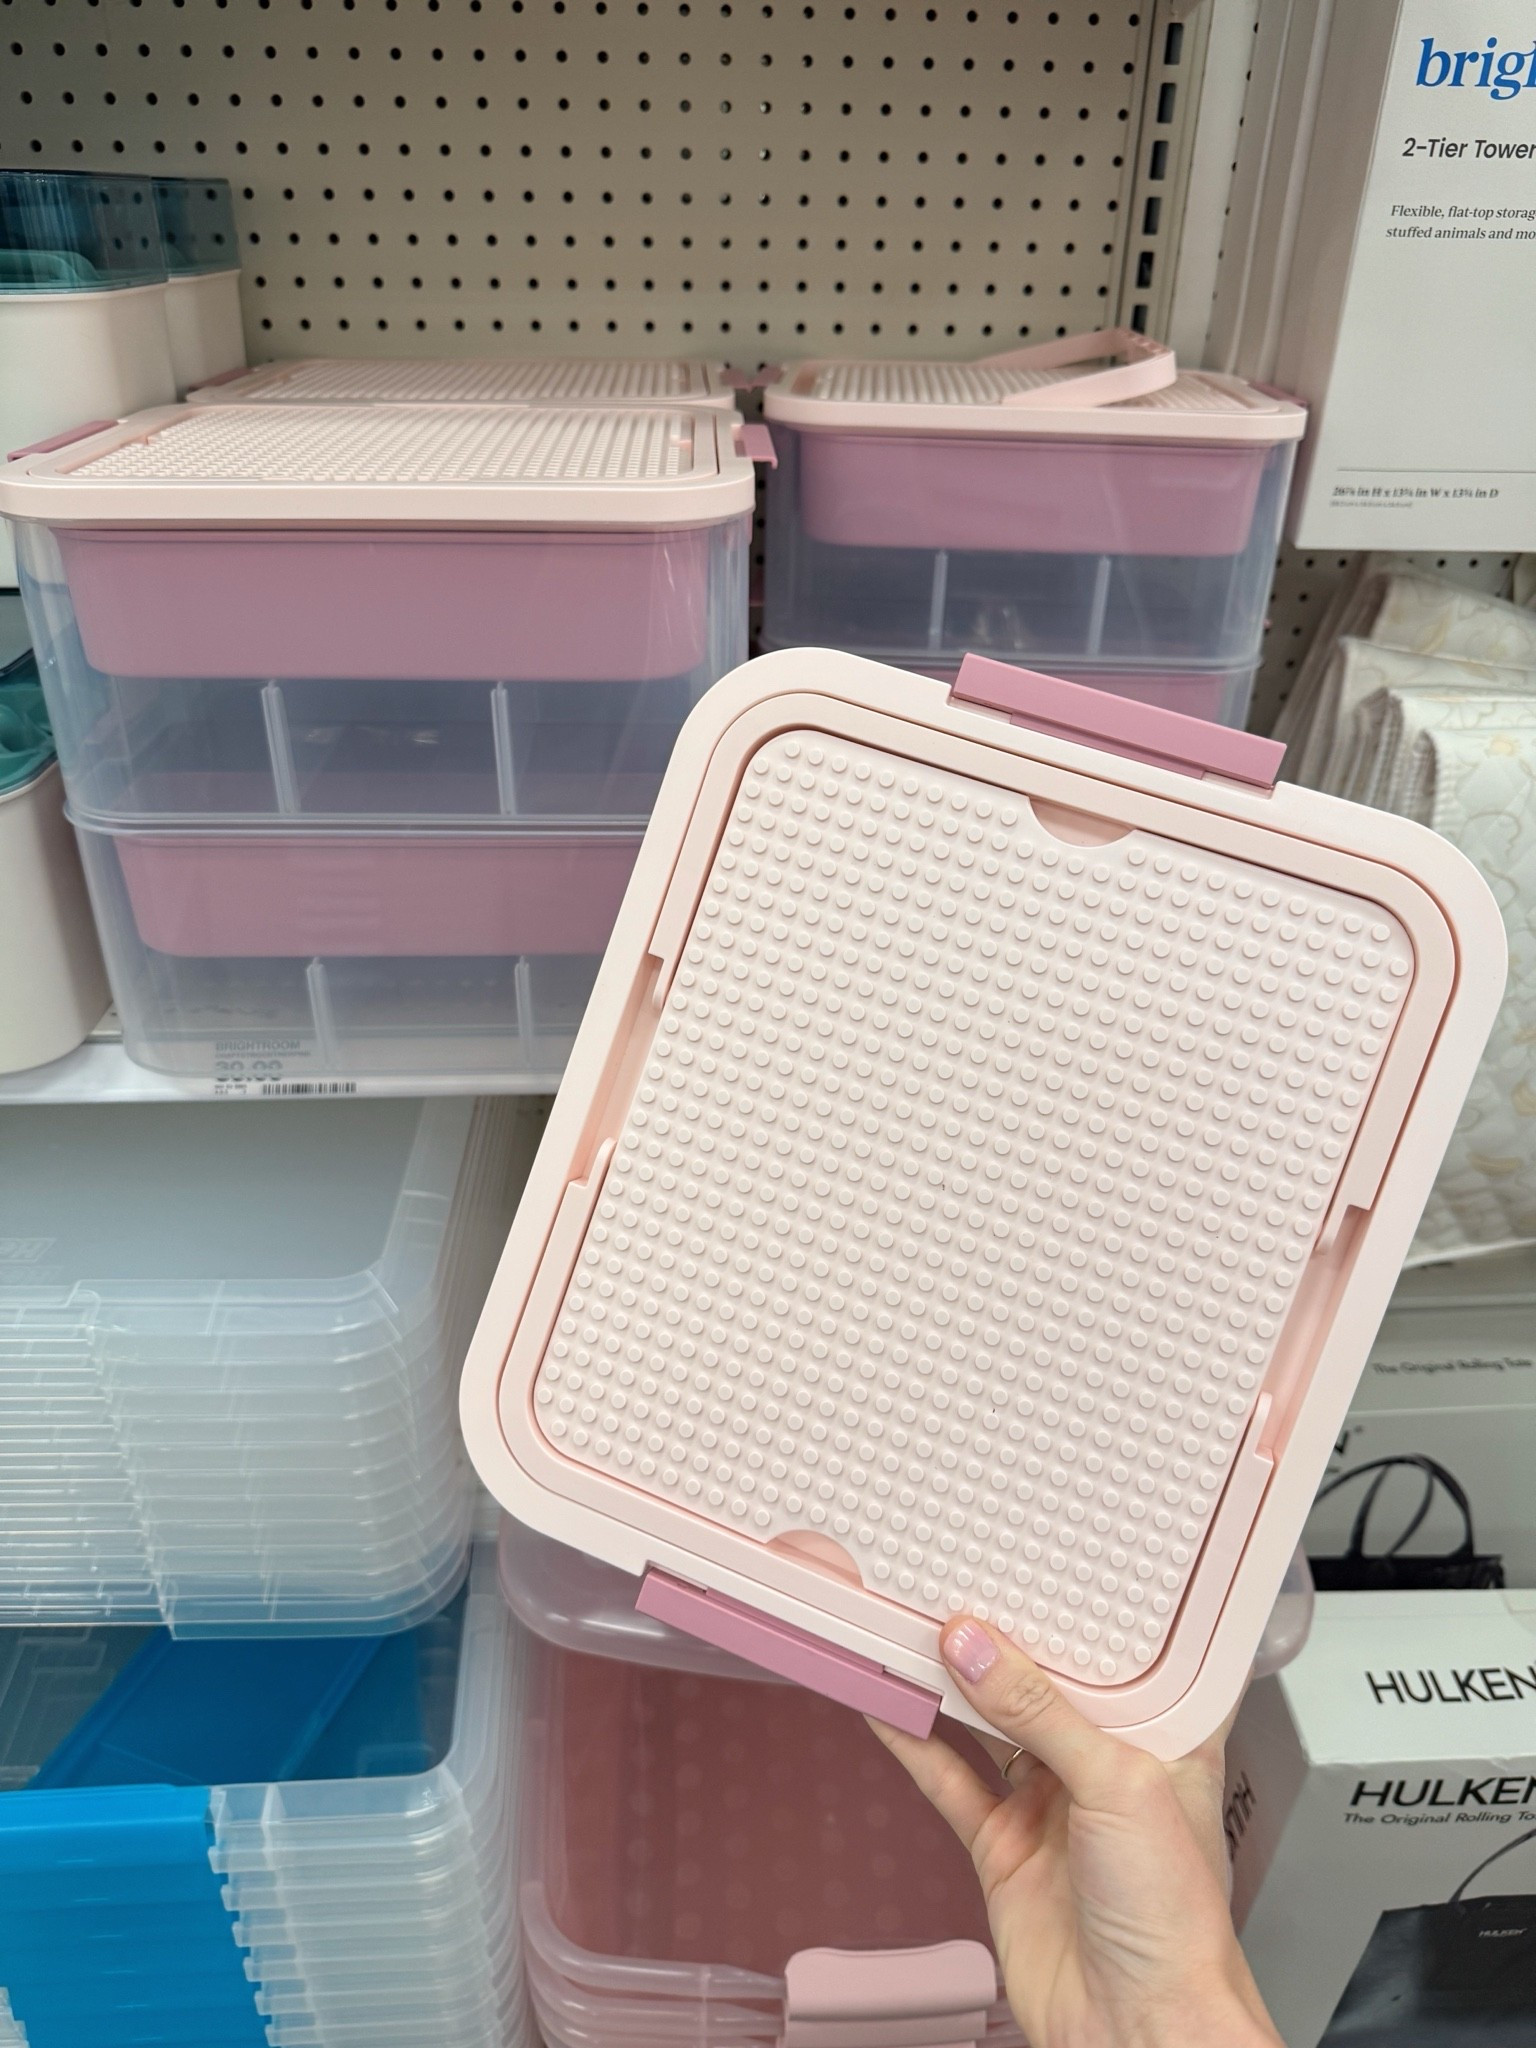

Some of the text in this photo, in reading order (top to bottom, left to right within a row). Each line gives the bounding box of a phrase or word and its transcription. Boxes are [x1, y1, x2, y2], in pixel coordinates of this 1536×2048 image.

[1402, 137, 1536, 159] 2-Tier Tower
[1390, 204, 1536, 221] Flexible, flat-top storag
[1385, 226, 1432, 238] stuffed
[1434, 227, 1486, 239] animals
[1488, 228, 1513, 239] and
[1365, 1666, 1536, 1704] HULKEN
[1344, 1811, 1536, 1826] The Original Rolling To
